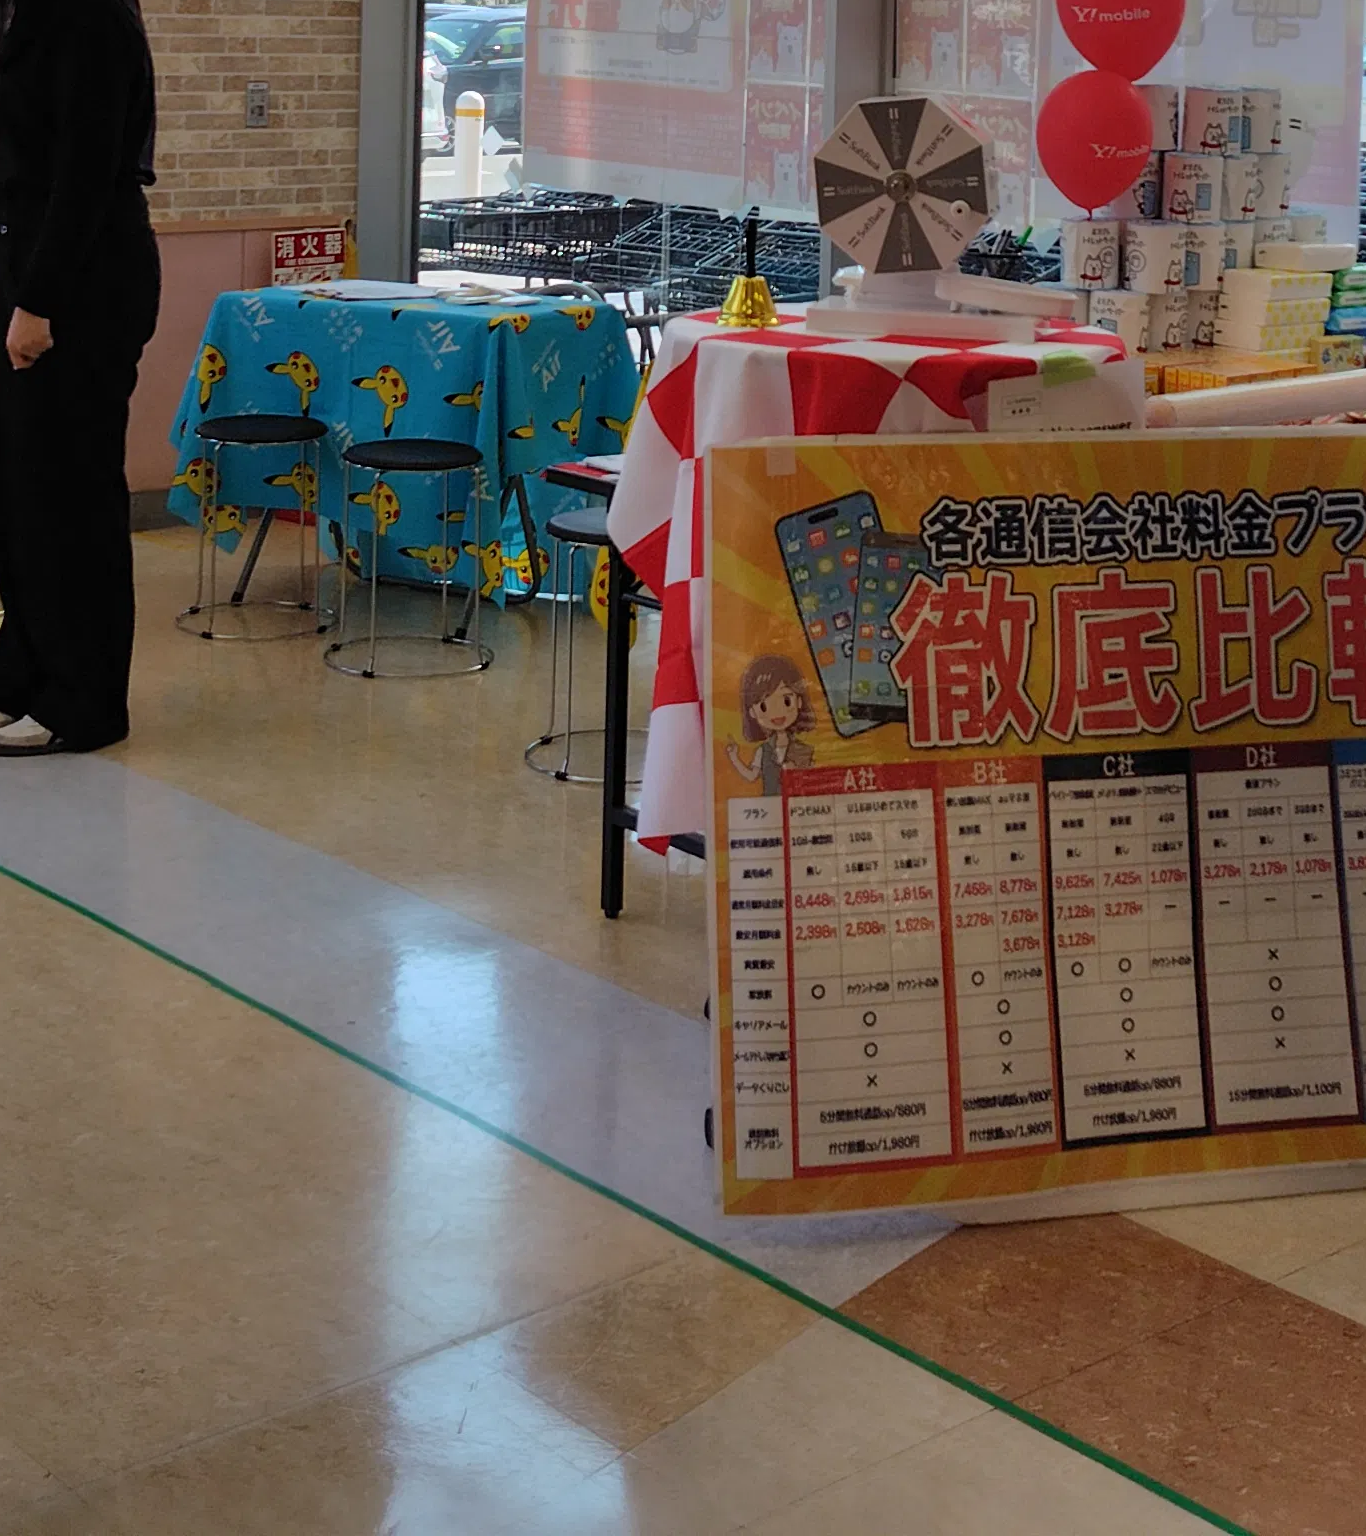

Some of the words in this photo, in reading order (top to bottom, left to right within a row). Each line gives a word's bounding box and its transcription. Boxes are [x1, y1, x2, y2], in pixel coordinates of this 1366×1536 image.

[277, 233, 343, 258] 消火器
[843, 768, 877, 791] A社
[974, 763, 1008, 784] B社
[1103, 753, 1135, 777] C社
[1245, 746, 1277, 767] D社
